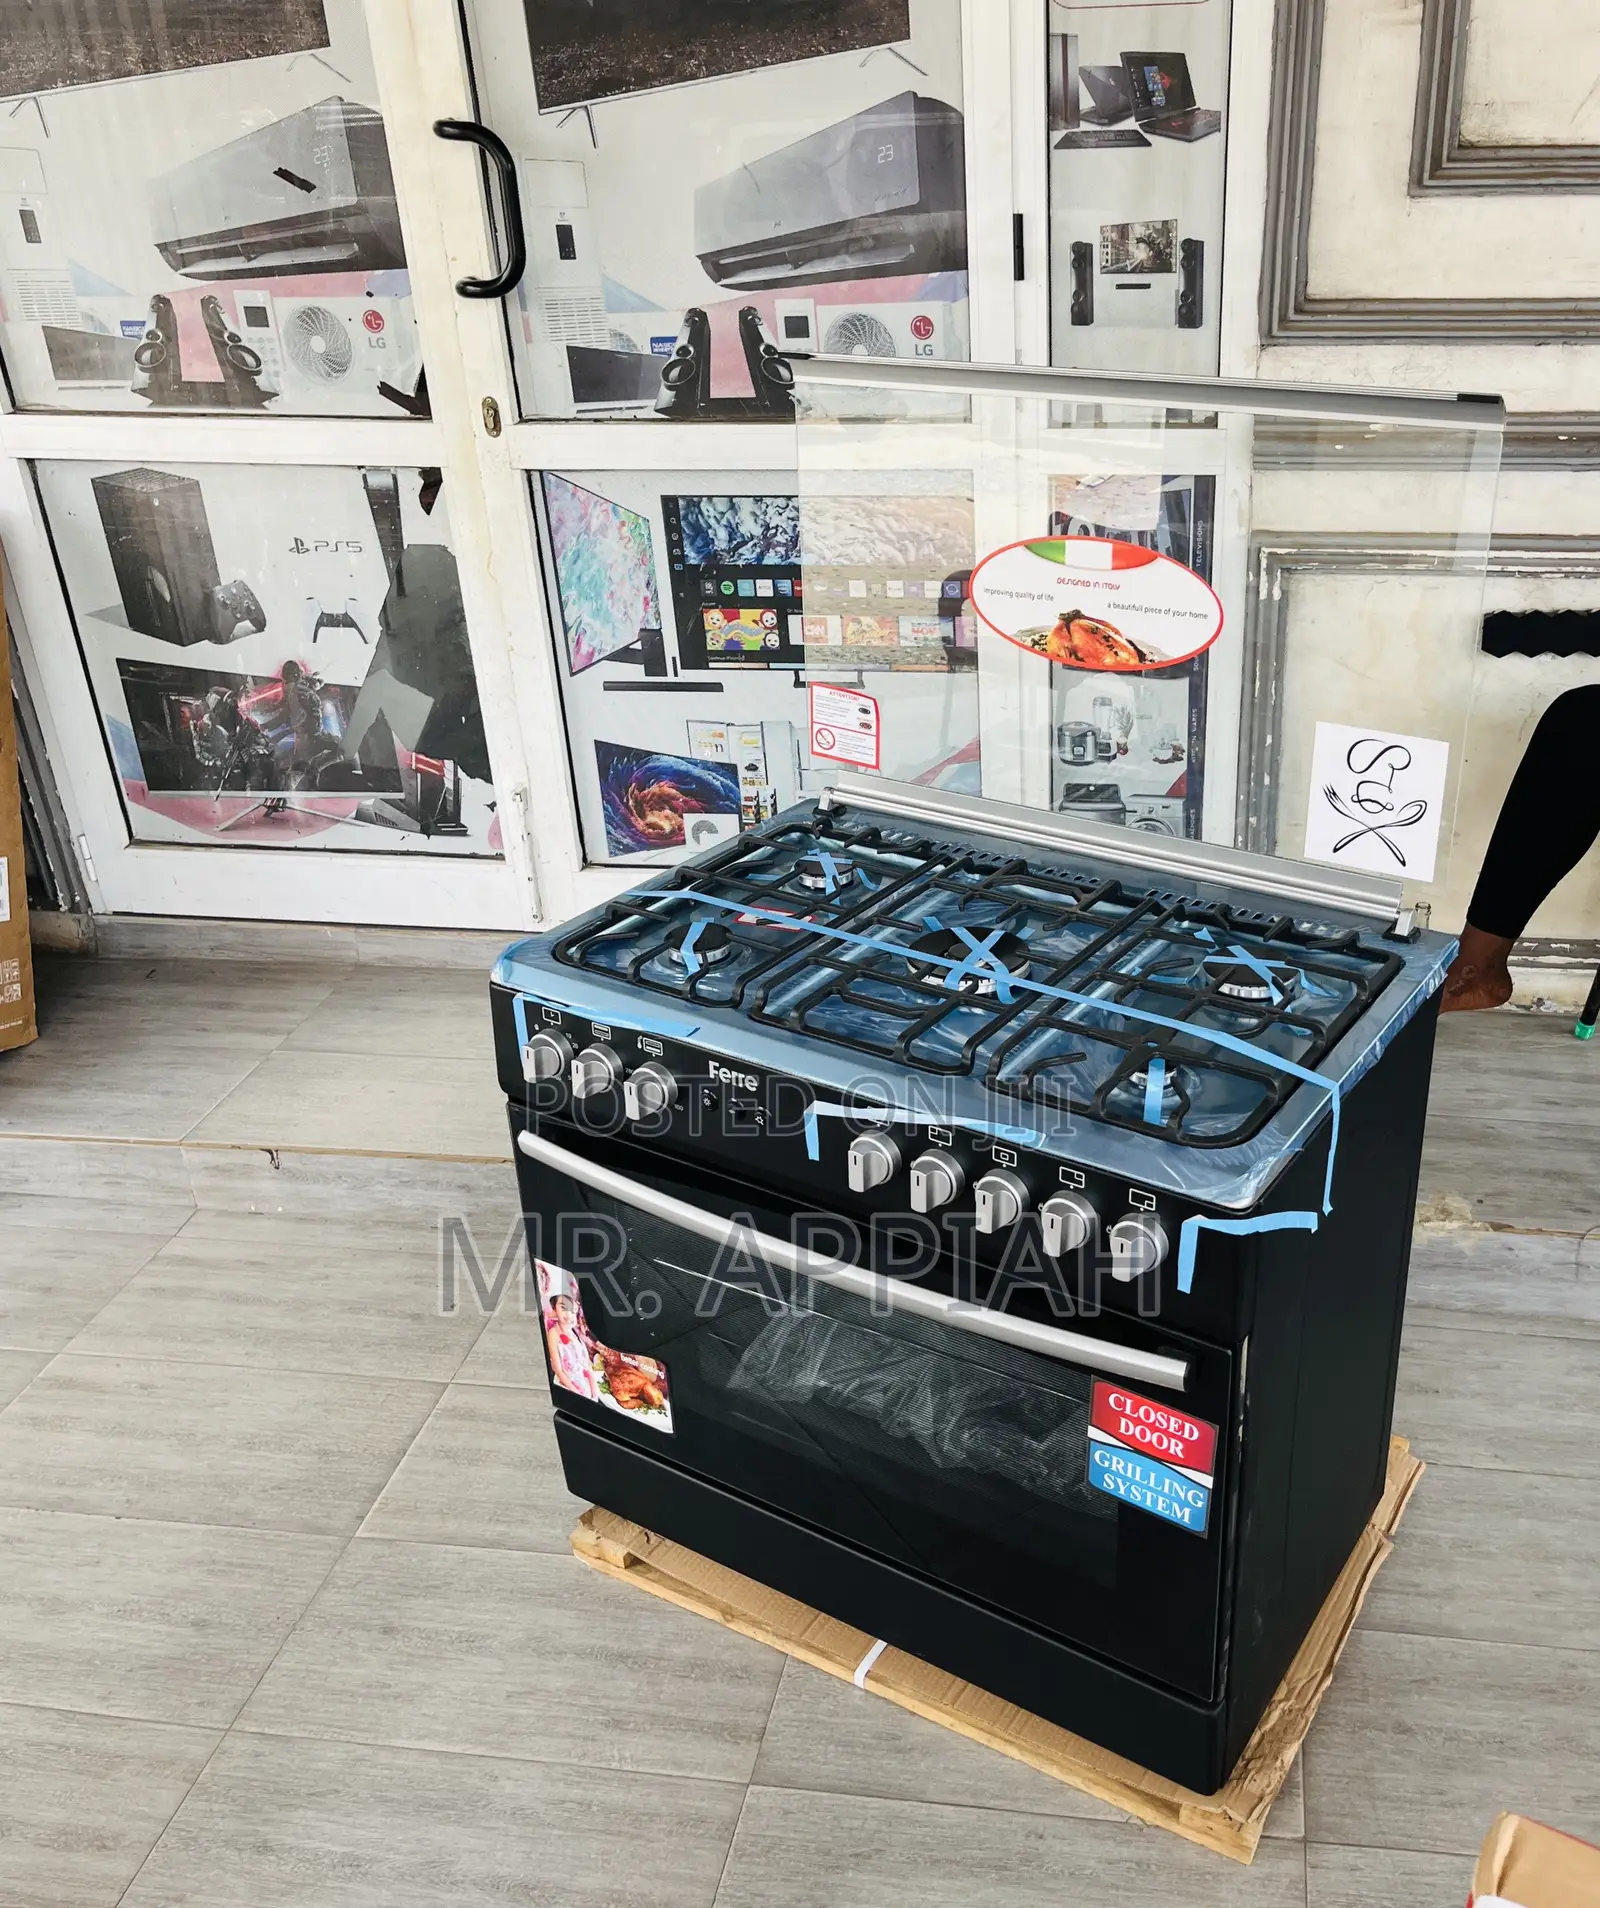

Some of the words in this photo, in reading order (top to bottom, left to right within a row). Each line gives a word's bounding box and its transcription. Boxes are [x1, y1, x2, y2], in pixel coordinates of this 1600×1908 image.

[878, 144, 894, 163] 23
[368, 337, 386, 349] LG
[915, 344, 933, 356] LG
[313, 540, 363, 553] PS5
[1195, 519, 1204, 568] TELEVISIONS
[1056, 577, 1091, 588] DESIGNED
[1101, 582, 1121, 591] ITALY
[983, 587, 1014, 599] improving
[1014, 591, 1036, 601] quality
[1044, 594, 1055, 602] life
[1112, 602, 1143, 612] beautifull
[1144, 606, 1162, 614] piece
[1189, 611, 1208, 620] home
[708, 1060, 758, 1092] Ferre
[1107, 1393, 1200, 1441] CLOSED
[1118, 1417, 1185, 1459] DOOR
[1093, 1450, 1205, 1508] GRILLING
[1102, 1474, 1192, 1524] SYSTEM
